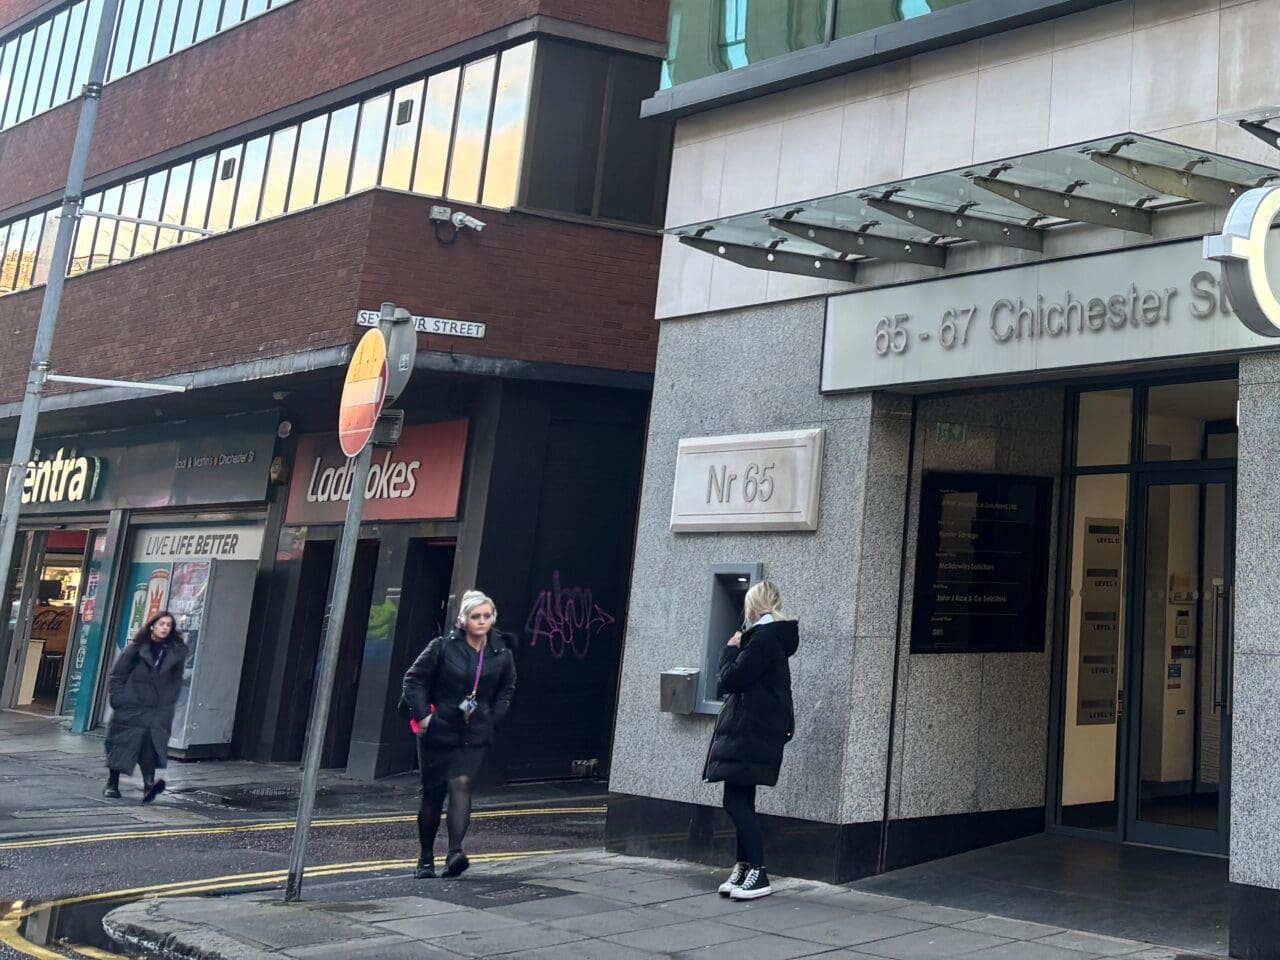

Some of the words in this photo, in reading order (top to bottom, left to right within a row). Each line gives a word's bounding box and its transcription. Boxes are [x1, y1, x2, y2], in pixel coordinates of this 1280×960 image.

[433, 320, 483, 336] STREET
[873, 313, 910, 357] 65
[938, 303, 977, 350] 67
[988, 281, 1178, 342] Chichester
[6, 447, 88, 504] entra
[307, 451, 420, 502] Ladbokes
[705, 464, 737, 504] Nr
[743, 461, 776, 503] 65
[145, 535, 170, 555] LIVE
[169, 535, 195, 555] LIFE
[194, 533, 239, 554] BETTER
